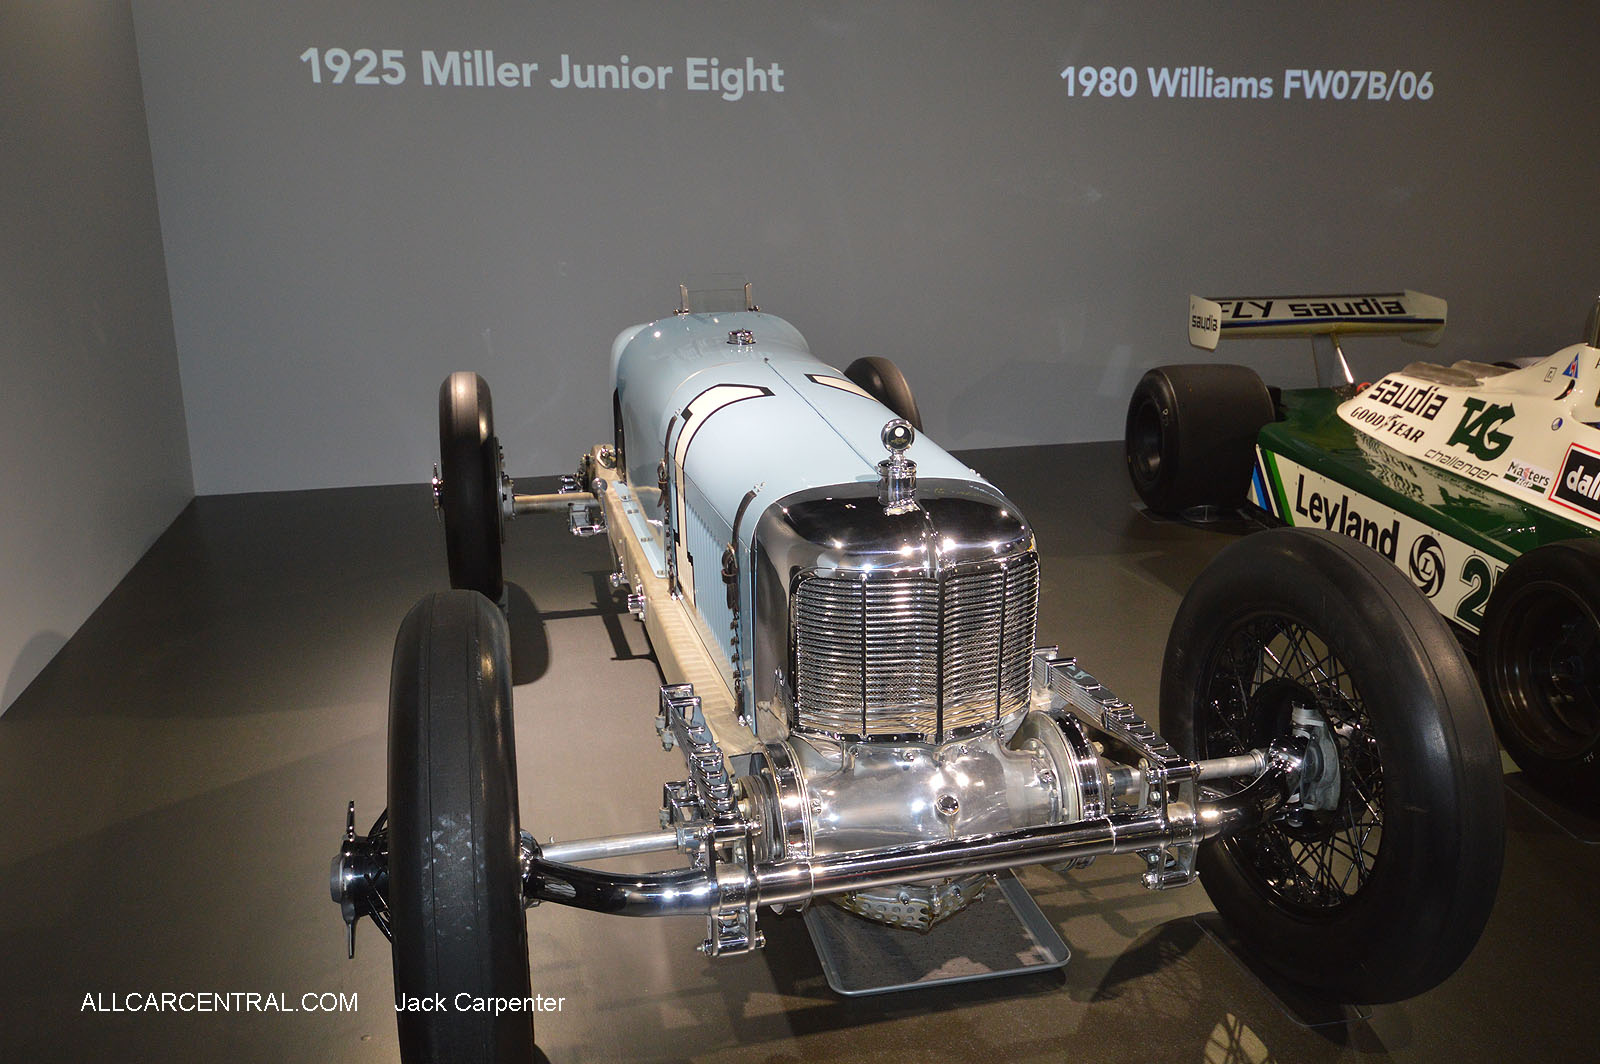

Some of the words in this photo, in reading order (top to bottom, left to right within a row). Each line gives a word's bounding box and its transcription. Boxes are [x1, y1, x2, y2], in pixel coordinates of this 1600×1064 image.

[301, 48, 405, 84] 1925
[422, 50, 538, 87] Miller
[551, 54, 672, 89] Junior
[687, 57, 784, 101] Eight
[1061, 66, 1137, 97] 1980
[1147, 66, 1273, 98] Williams
[1284, 70, 1433, 100] FW07B/06
[1191, 315, 1218, 332] saudia
[1288, 298, 1406, 317] saudia
[1368, 379, 1448, 421] saudia
[1446, 397, 1516, 461] TAG
[1424, 448, 1499, 481] challenger
[1296, 473, 1400, 564] Leyland
